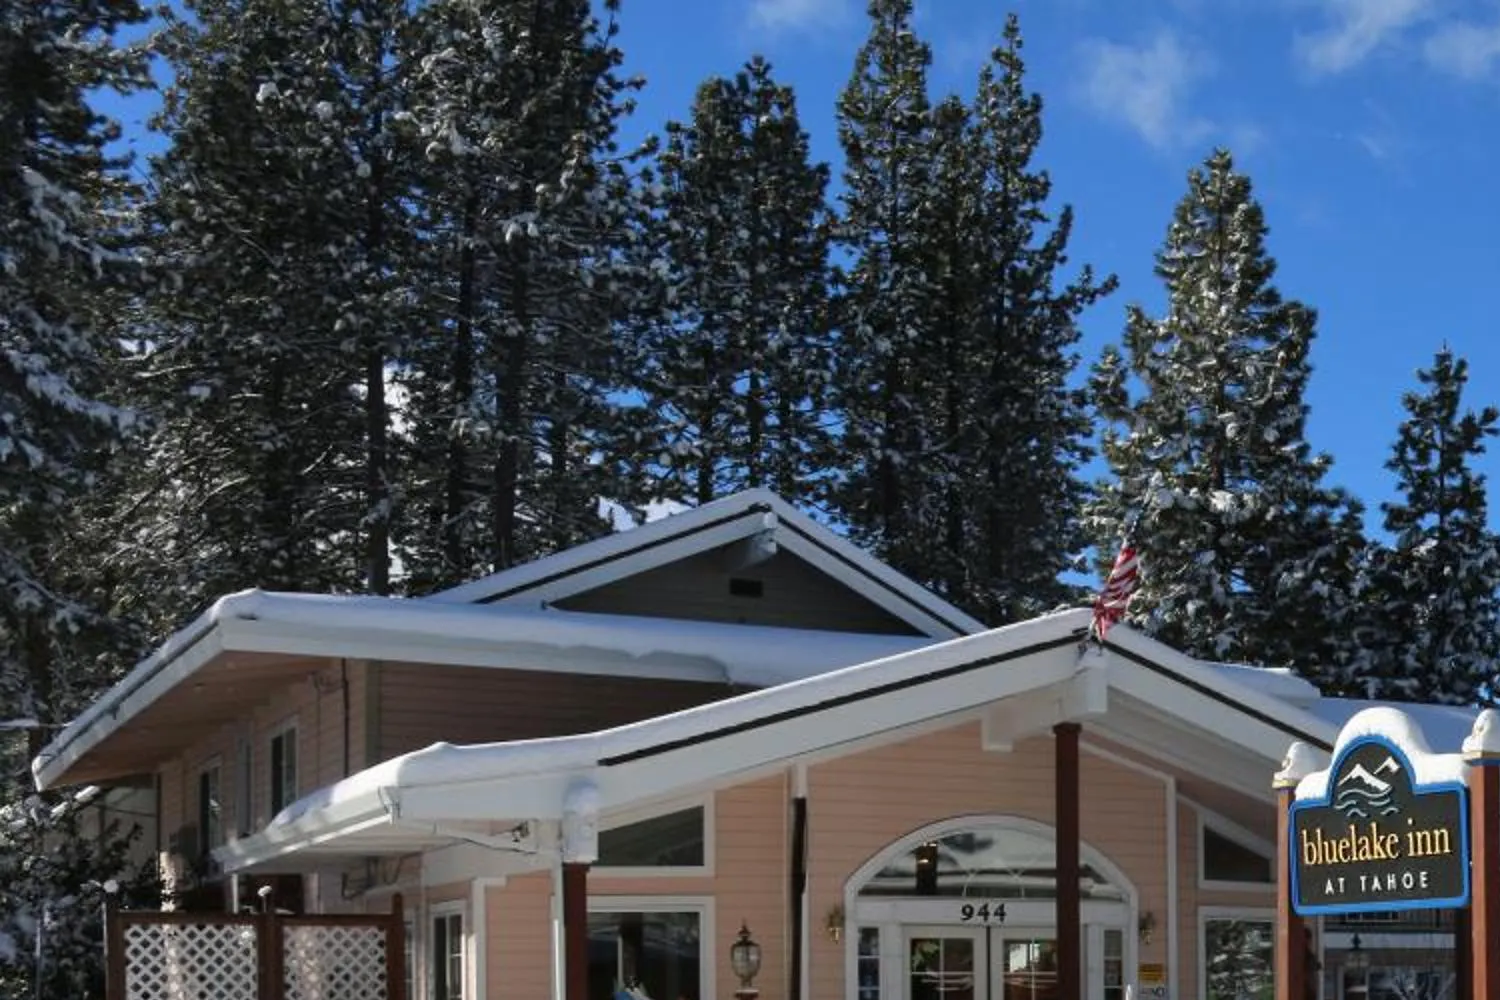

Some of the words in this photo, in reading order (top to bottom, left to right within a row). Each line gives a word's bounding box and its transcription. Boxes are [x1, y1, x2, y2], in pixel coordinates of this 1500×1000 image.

[1302, 822, 1400, 865] bluelake
[1407, 818, 1452, 857] inn
[1325, 877, 1345, 895] AT
[1360, 871, 1429, 892] TAHOE
[961, 903, 1007, 922] 944
